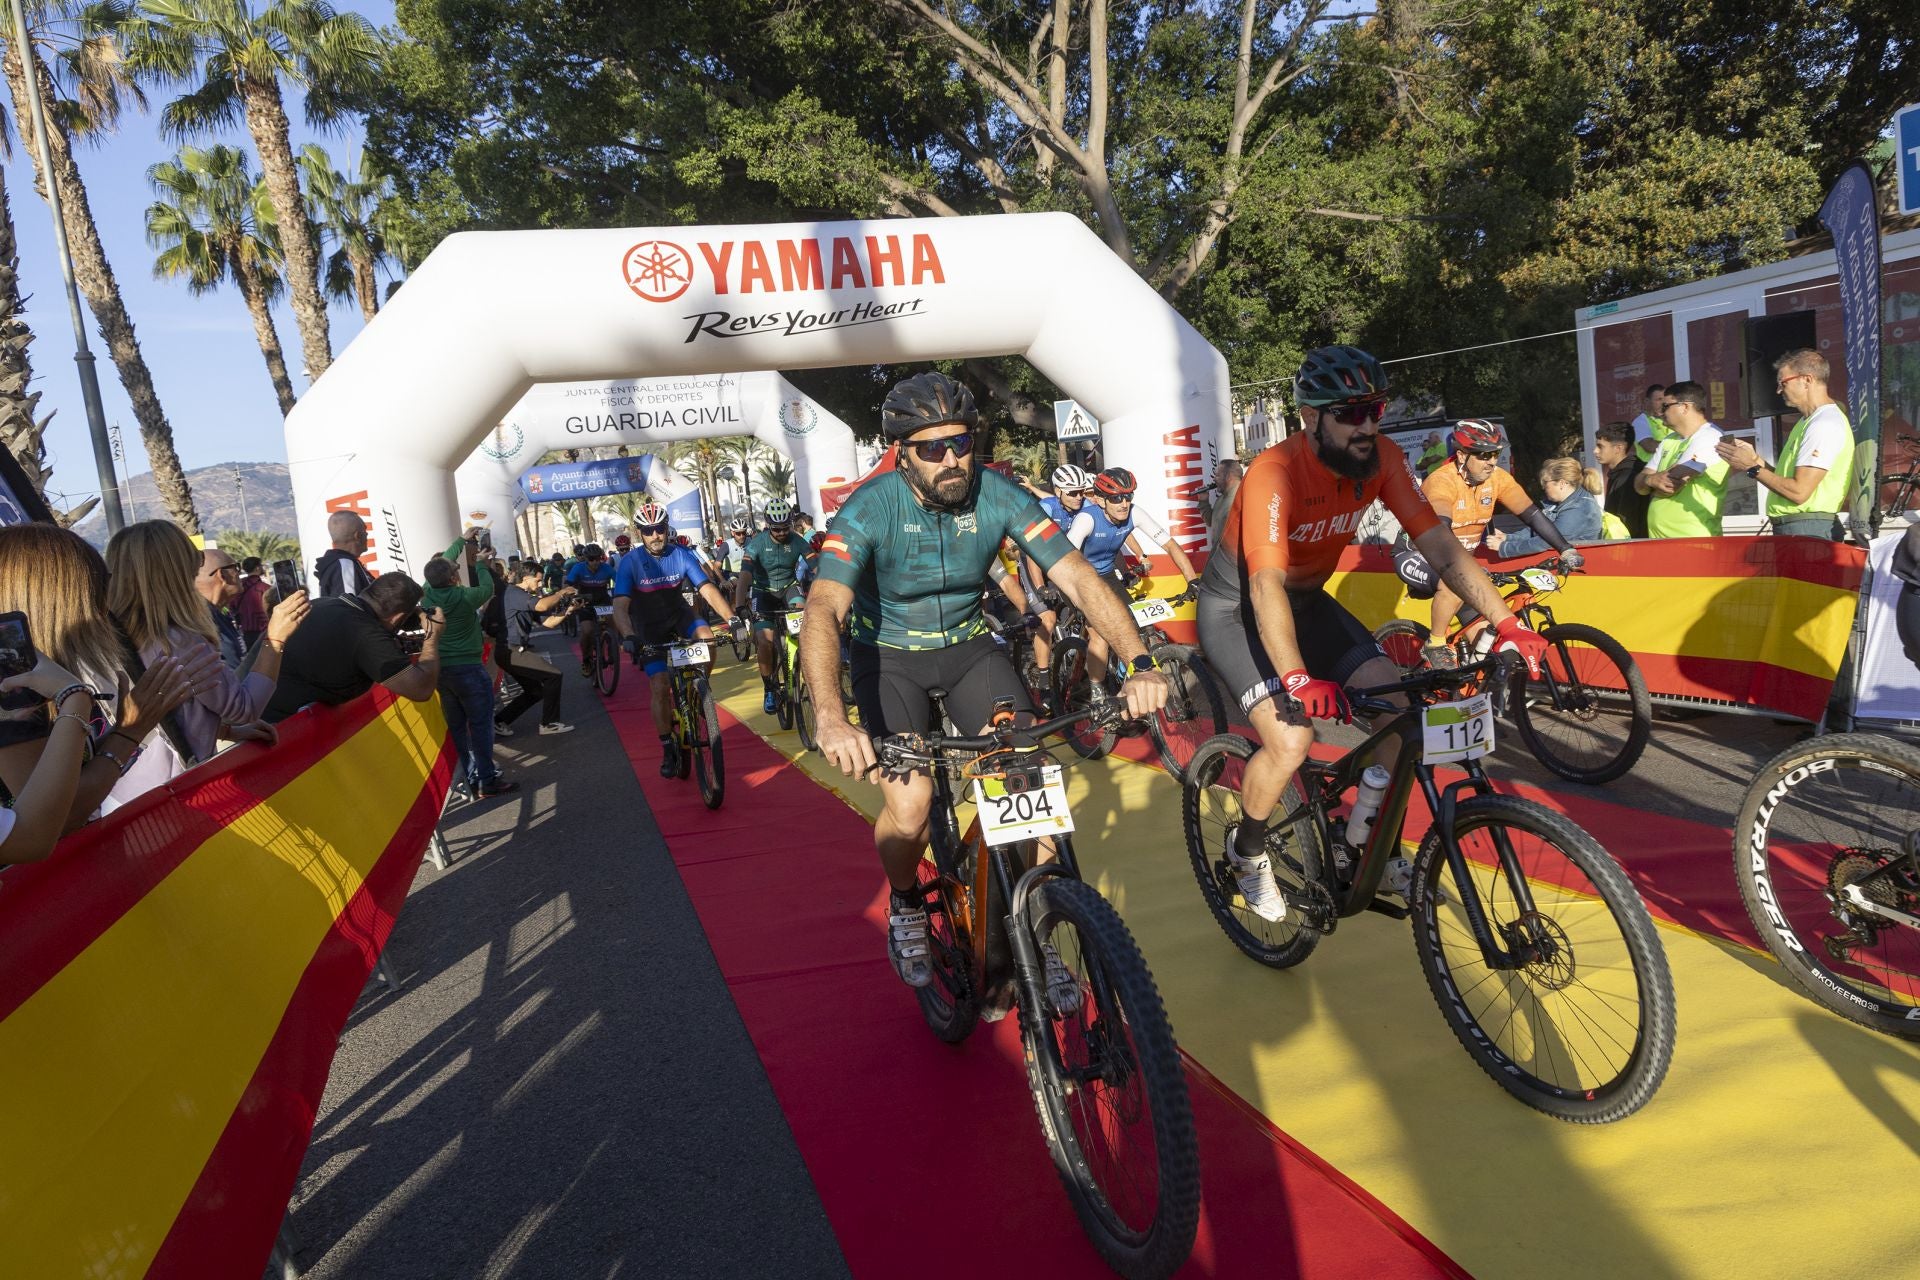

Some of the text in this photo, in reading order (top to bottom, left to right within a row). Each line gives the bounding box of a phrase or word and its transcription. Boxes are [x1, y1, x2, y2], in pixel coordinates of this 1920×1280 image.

[697, 233, 946, 295] YAMAHA
[682, 297, 924, 344] Revs Your Heart
[565, 379, 735, 397] JUNTA CENTRAL DE EDUCACIÓN
[601, 392, 703, 407] FÍSICA Y DEPORTES
[565, 405, 739, 434] GUARDIA CIVIL
[551, 467, 619, 482] Ayuntamiento
[551, 477, 620, 493] Cartagena
[1163, 424, 1208, 552] AMAHA
[382, 507, 405, 563] Heart
[1289, 508, 1364, 542] CC EL PALM
[1141, 604, 1165, 619] 129
[680, 647, 702, 658] 206
[1241, 677, 1280, 711] PALMAR
[1444, 718, 1484, 749] 112
[998, 790, 1053, 824] 204
[1421, 834, 1440, 869] BARZ
[1751, 758, 1836, 952] BONTRAGER
[1818, 973, 1880, 1012] KOVEE PRO 30
